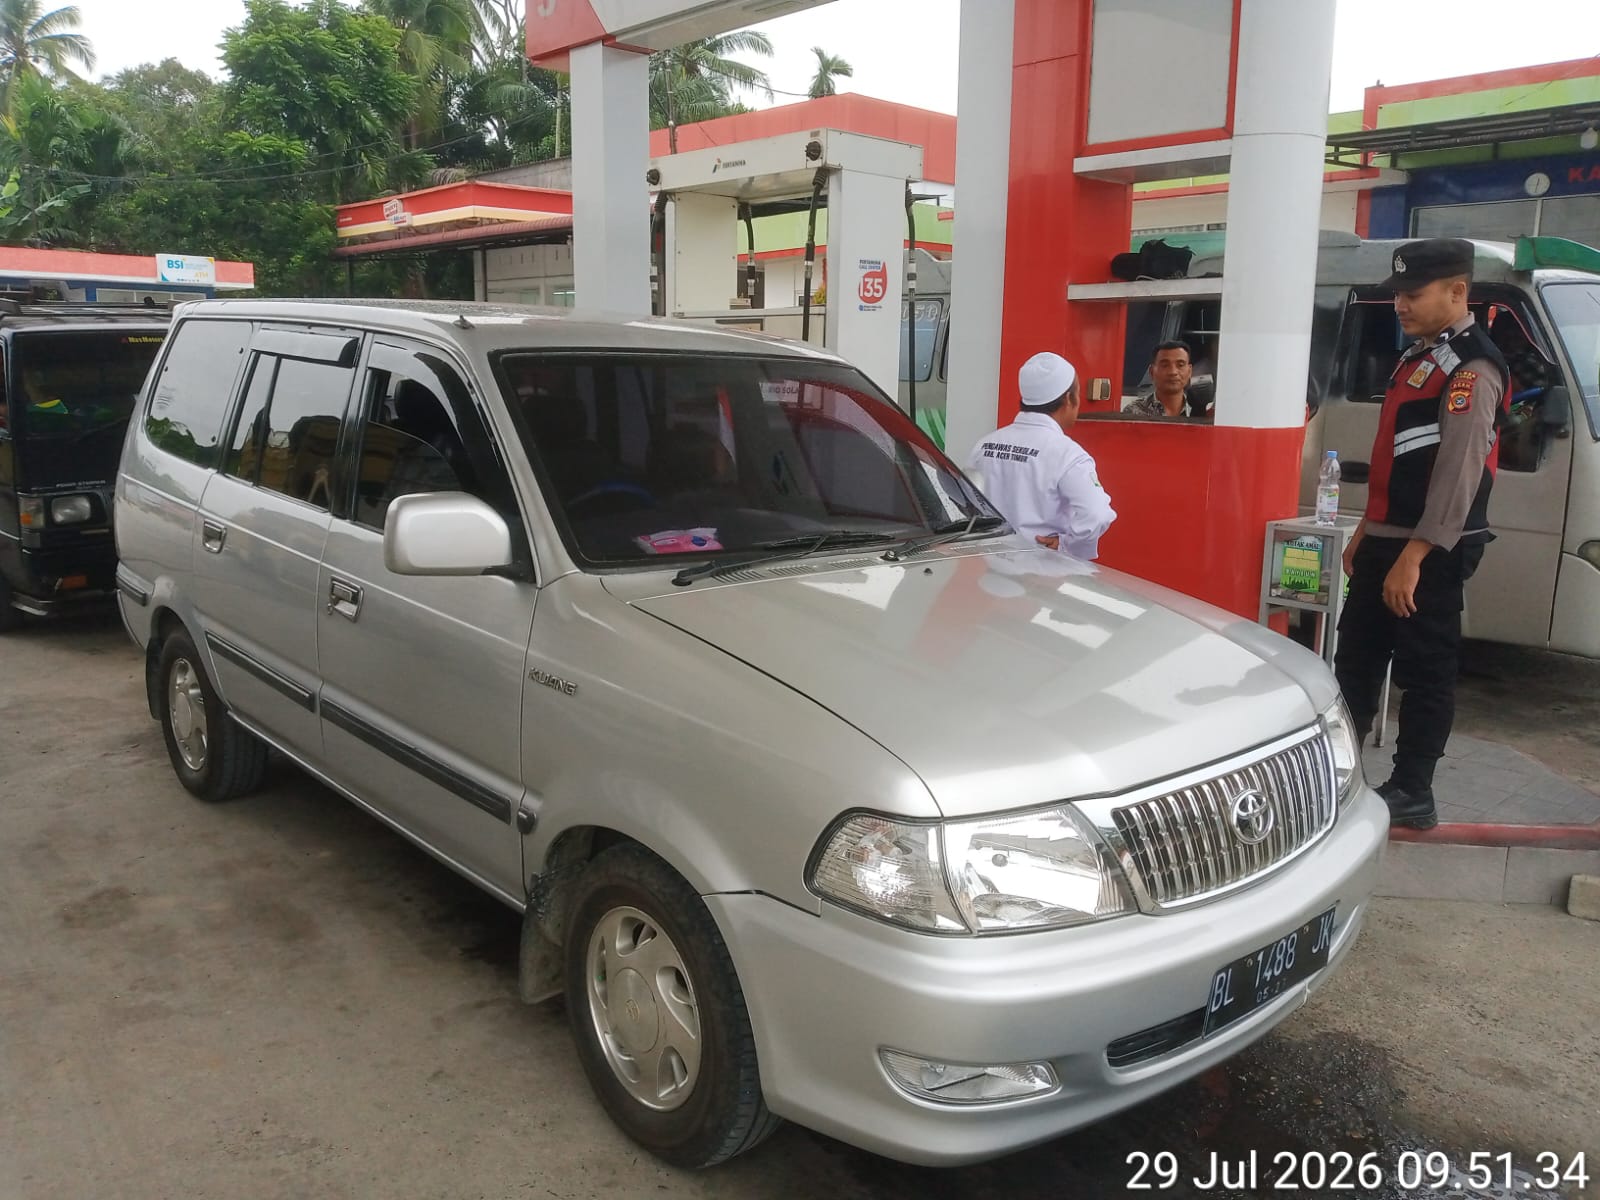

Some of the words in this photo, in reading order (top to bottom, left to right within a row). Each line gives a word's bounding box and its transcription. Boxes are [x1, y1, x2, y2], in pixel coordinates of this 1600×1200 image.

[167, 259, 184, 269] BSI
[859, 275, 884, 298] 135
[980, 442, 1012, 453] PENGAWAS
[1012, 445, 1040, 458] SEKOLAH
[1011, 453, 1028, 463] TIMUR
[1211, 967, 1234, 1013] BL
[1255, 931, 1298, 989] 1488
[1311, 910, 1335, 954] JK
